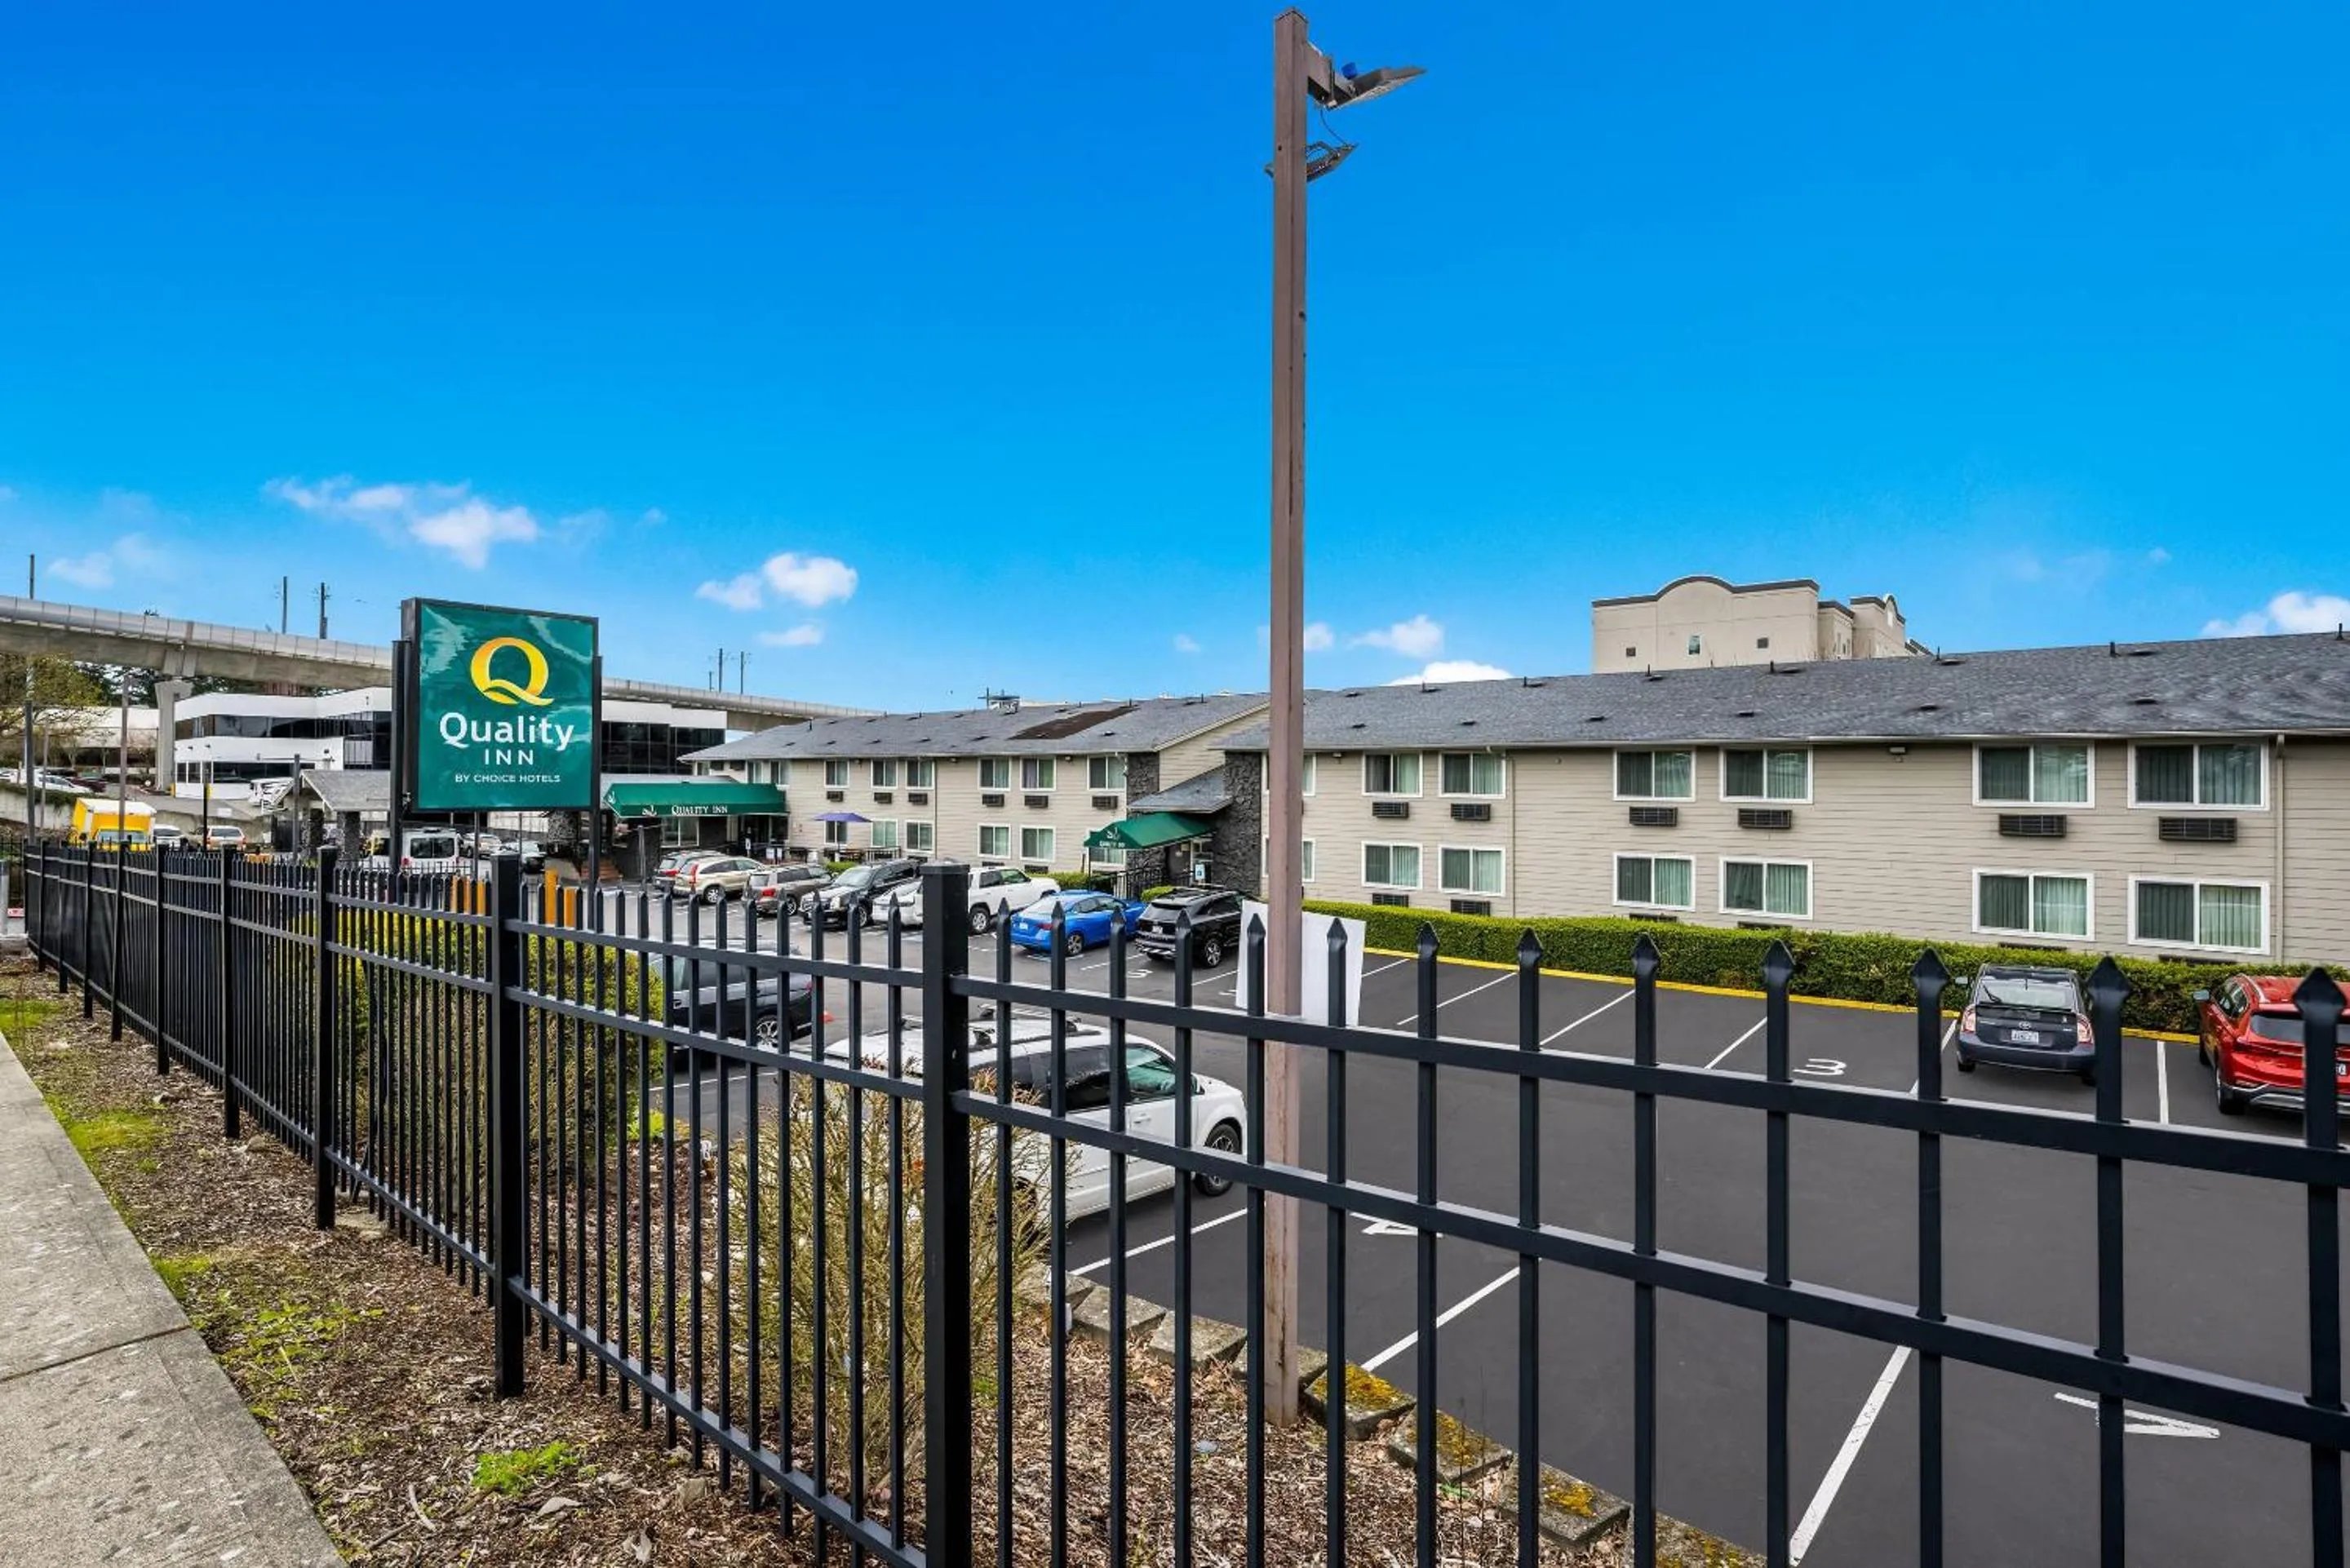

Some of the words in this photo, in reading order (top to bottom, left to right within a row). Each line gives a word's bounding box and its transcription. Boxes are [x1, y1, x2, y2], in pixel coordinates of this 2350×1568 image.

[471, 637, 555, 706] Q
[439, 711, 574, 751] Quality
[485, 749, 534, 765] INN
[454, 773, 470, 783] BY
[473, 773, 517, 783] CHOICE
[519, 774, 561, 783] HOTELS
